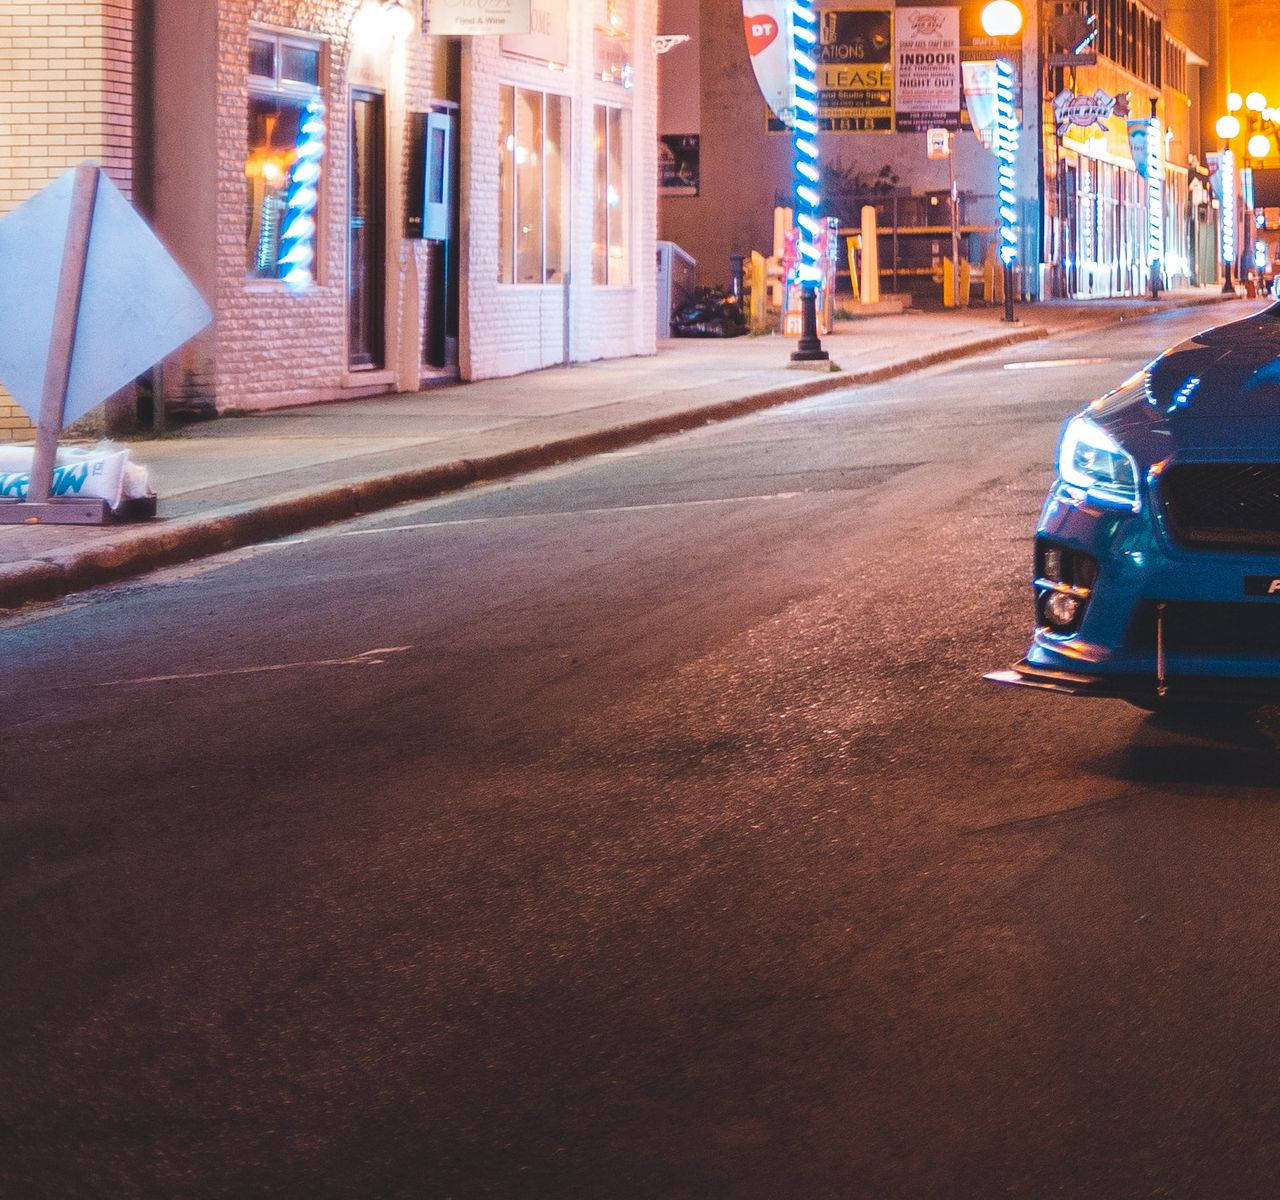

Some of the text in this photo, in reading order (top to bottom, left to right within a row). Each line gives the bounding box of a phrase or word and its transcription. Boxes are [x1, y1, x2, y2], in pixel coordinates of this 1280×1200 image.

[751, 24, 773, 37] DT
[899, 53, 956, 66] INDOOR
[825, 70, 892, 88] LEASE
[899, 79, 955, 88] NIGHT OUT
